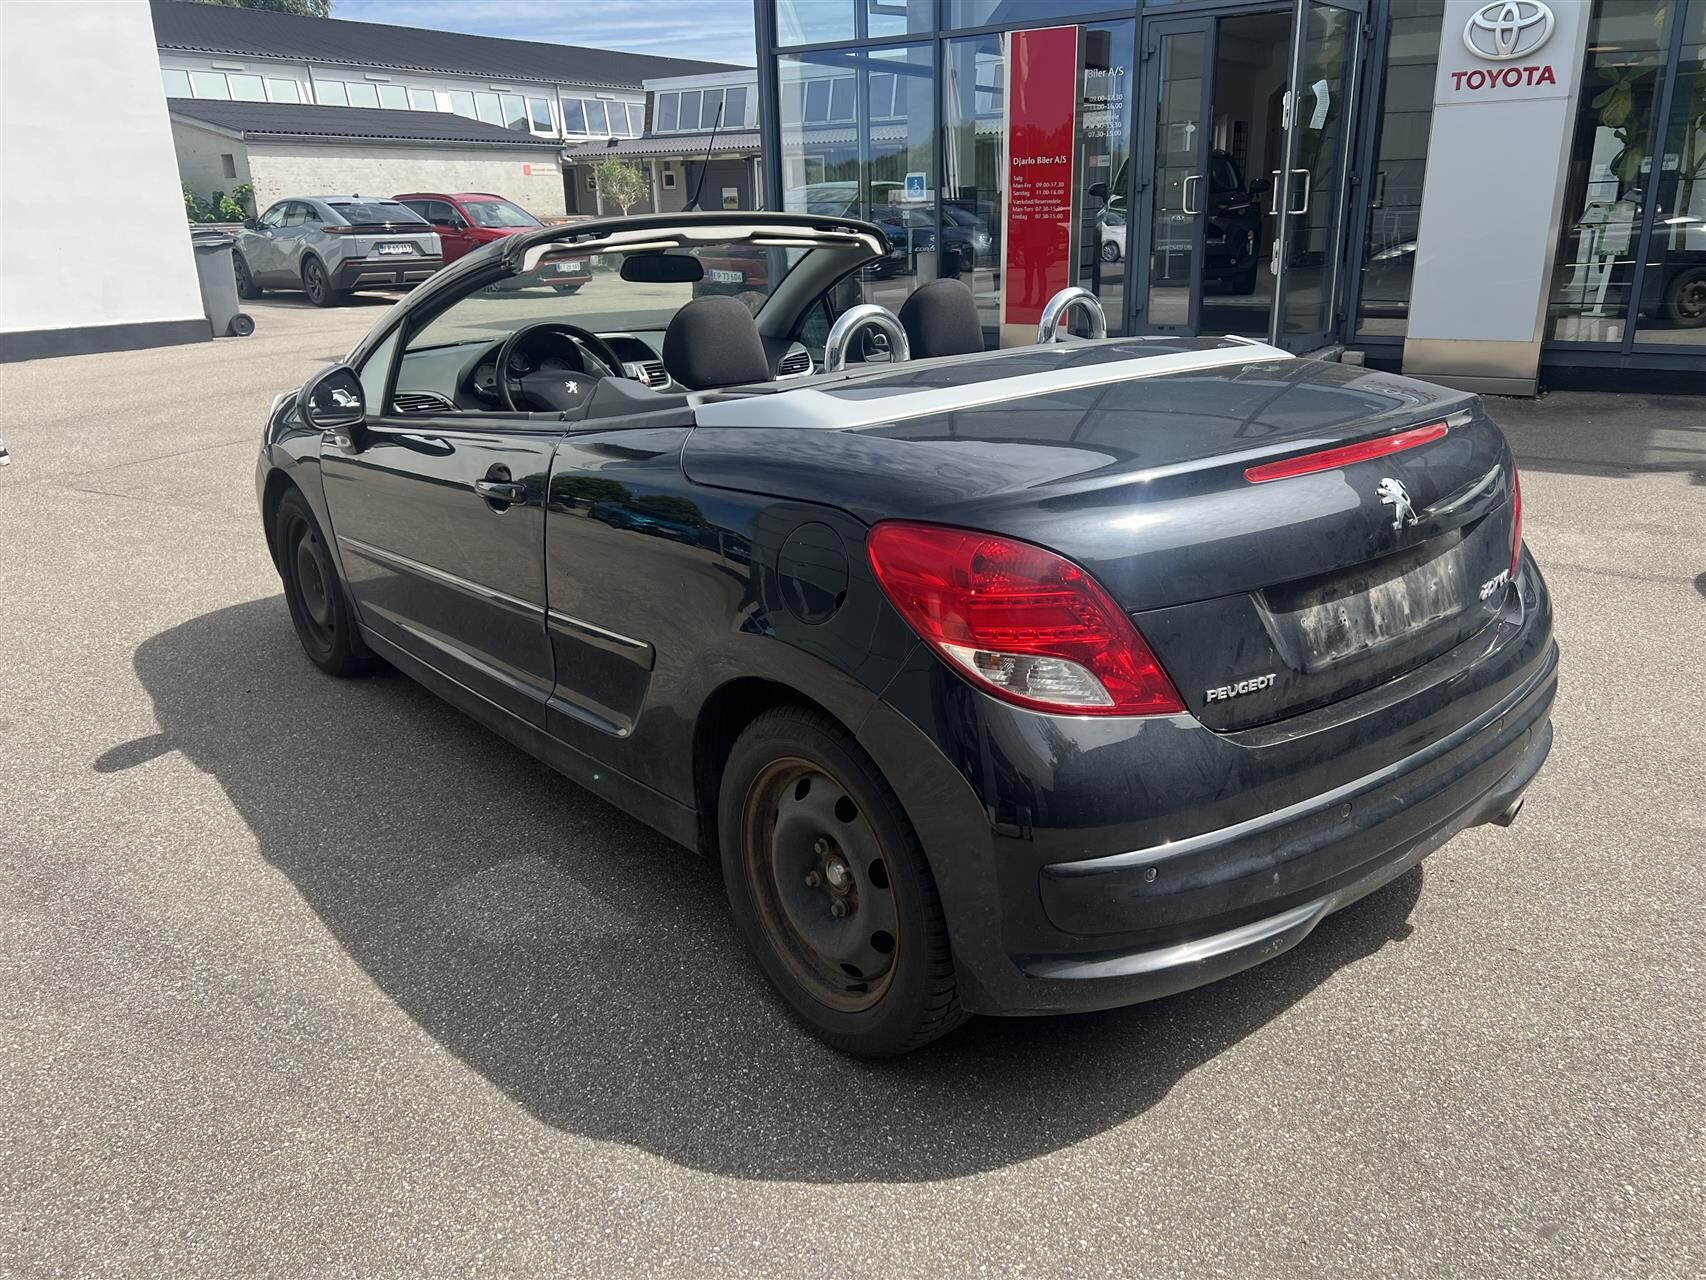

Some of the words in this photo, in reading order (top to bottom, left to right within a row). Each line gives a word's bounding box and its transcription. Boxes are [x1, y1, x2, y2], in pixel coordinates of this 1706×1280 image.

[1108, 66, 1124, 76] A/S
[1451, 65, 1556, 91] TOYOTA
[1013, 157, 1036, 167] Djarlo
[1037, 156, 1053, 165] Biler
[1054, 155, 1067, 164] A/S
[1206, 673, 1277, 703] PEUGEOT
